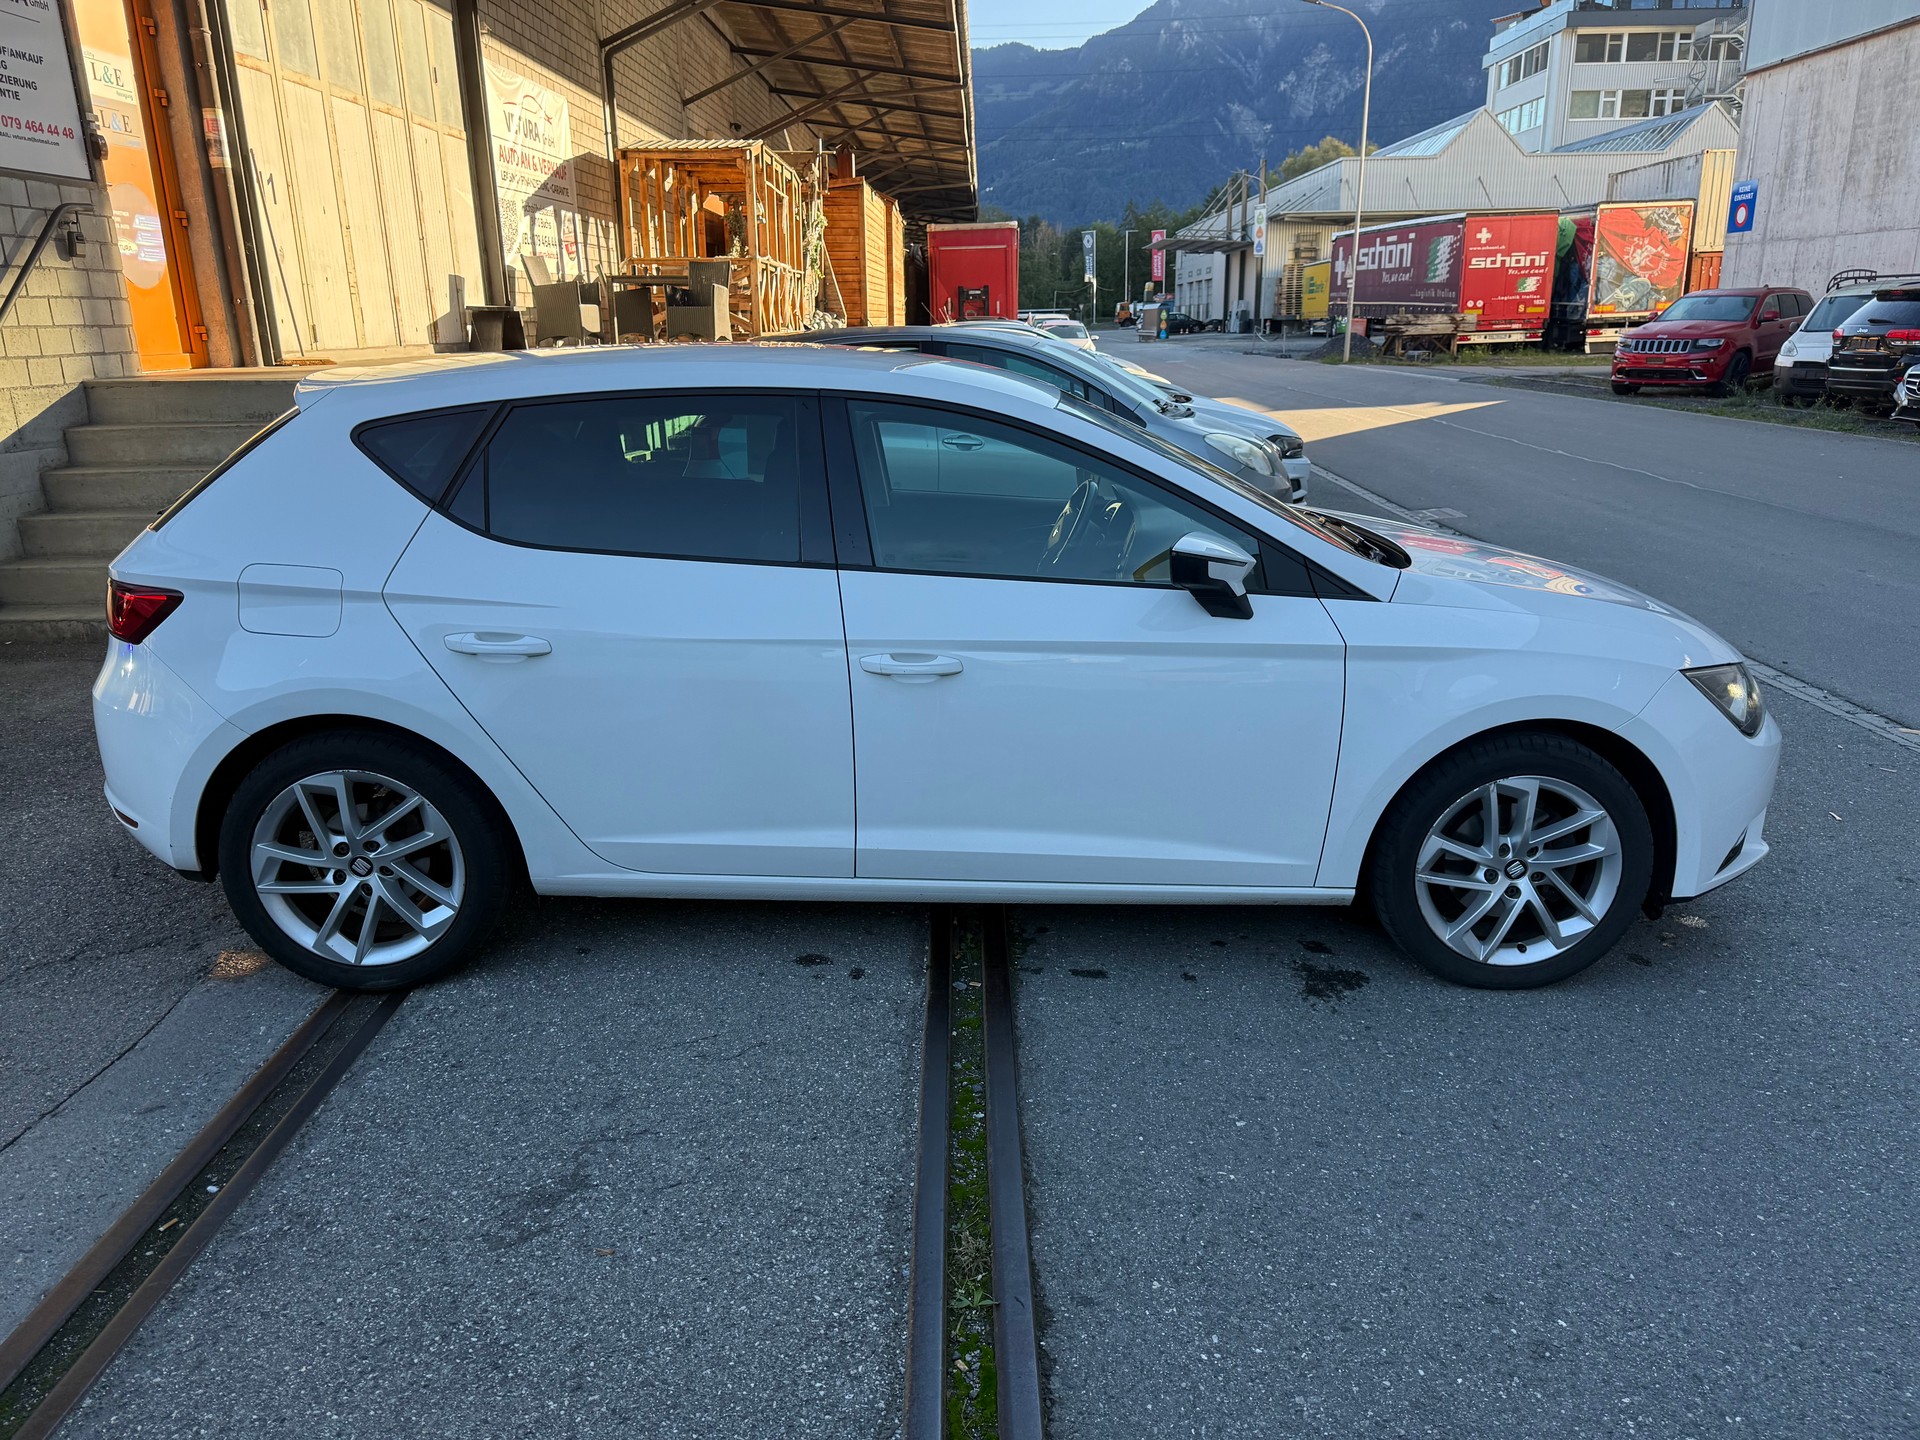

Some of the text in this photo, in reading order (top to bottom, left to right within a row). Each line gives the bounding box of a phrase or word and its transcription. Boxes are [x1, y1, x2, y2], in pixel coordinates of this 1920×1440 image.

[1, 114, 75, 140] 079 464 44 48
